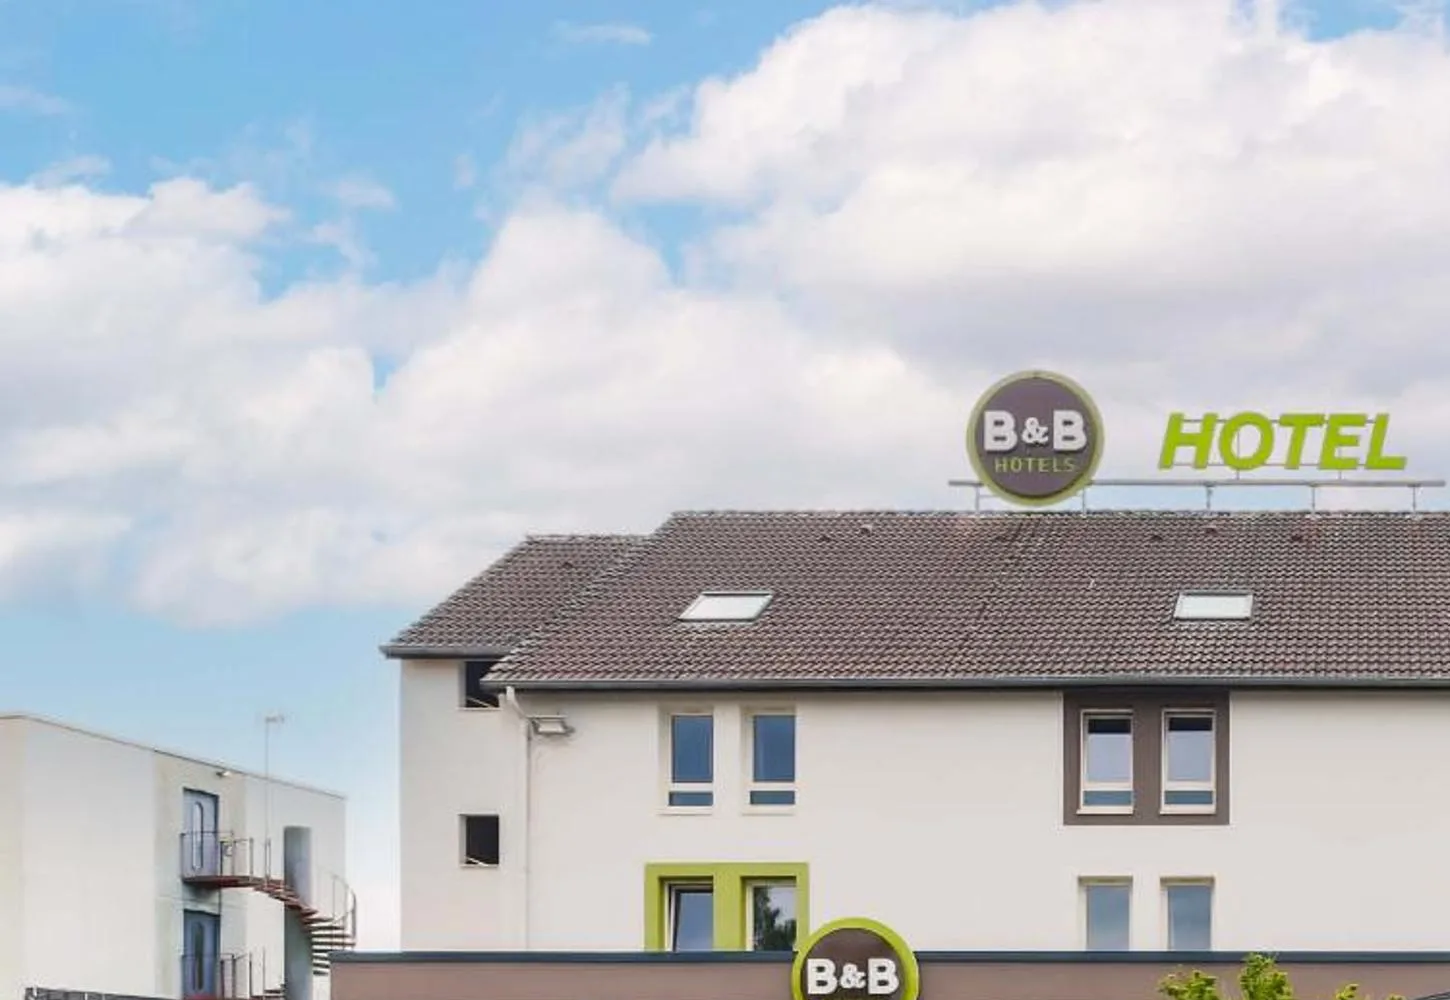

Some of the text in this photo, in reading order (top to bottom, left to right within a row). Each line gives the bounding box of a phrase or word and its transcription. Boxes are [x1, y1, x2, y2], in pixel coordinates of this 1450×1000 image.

[983, 409, 1088, 453] B&B
[1158, 410, 1408, 471] HOTEL
[994, 456, 1076, 473] HOTELS
[807, 957, 900, 995] B&B
